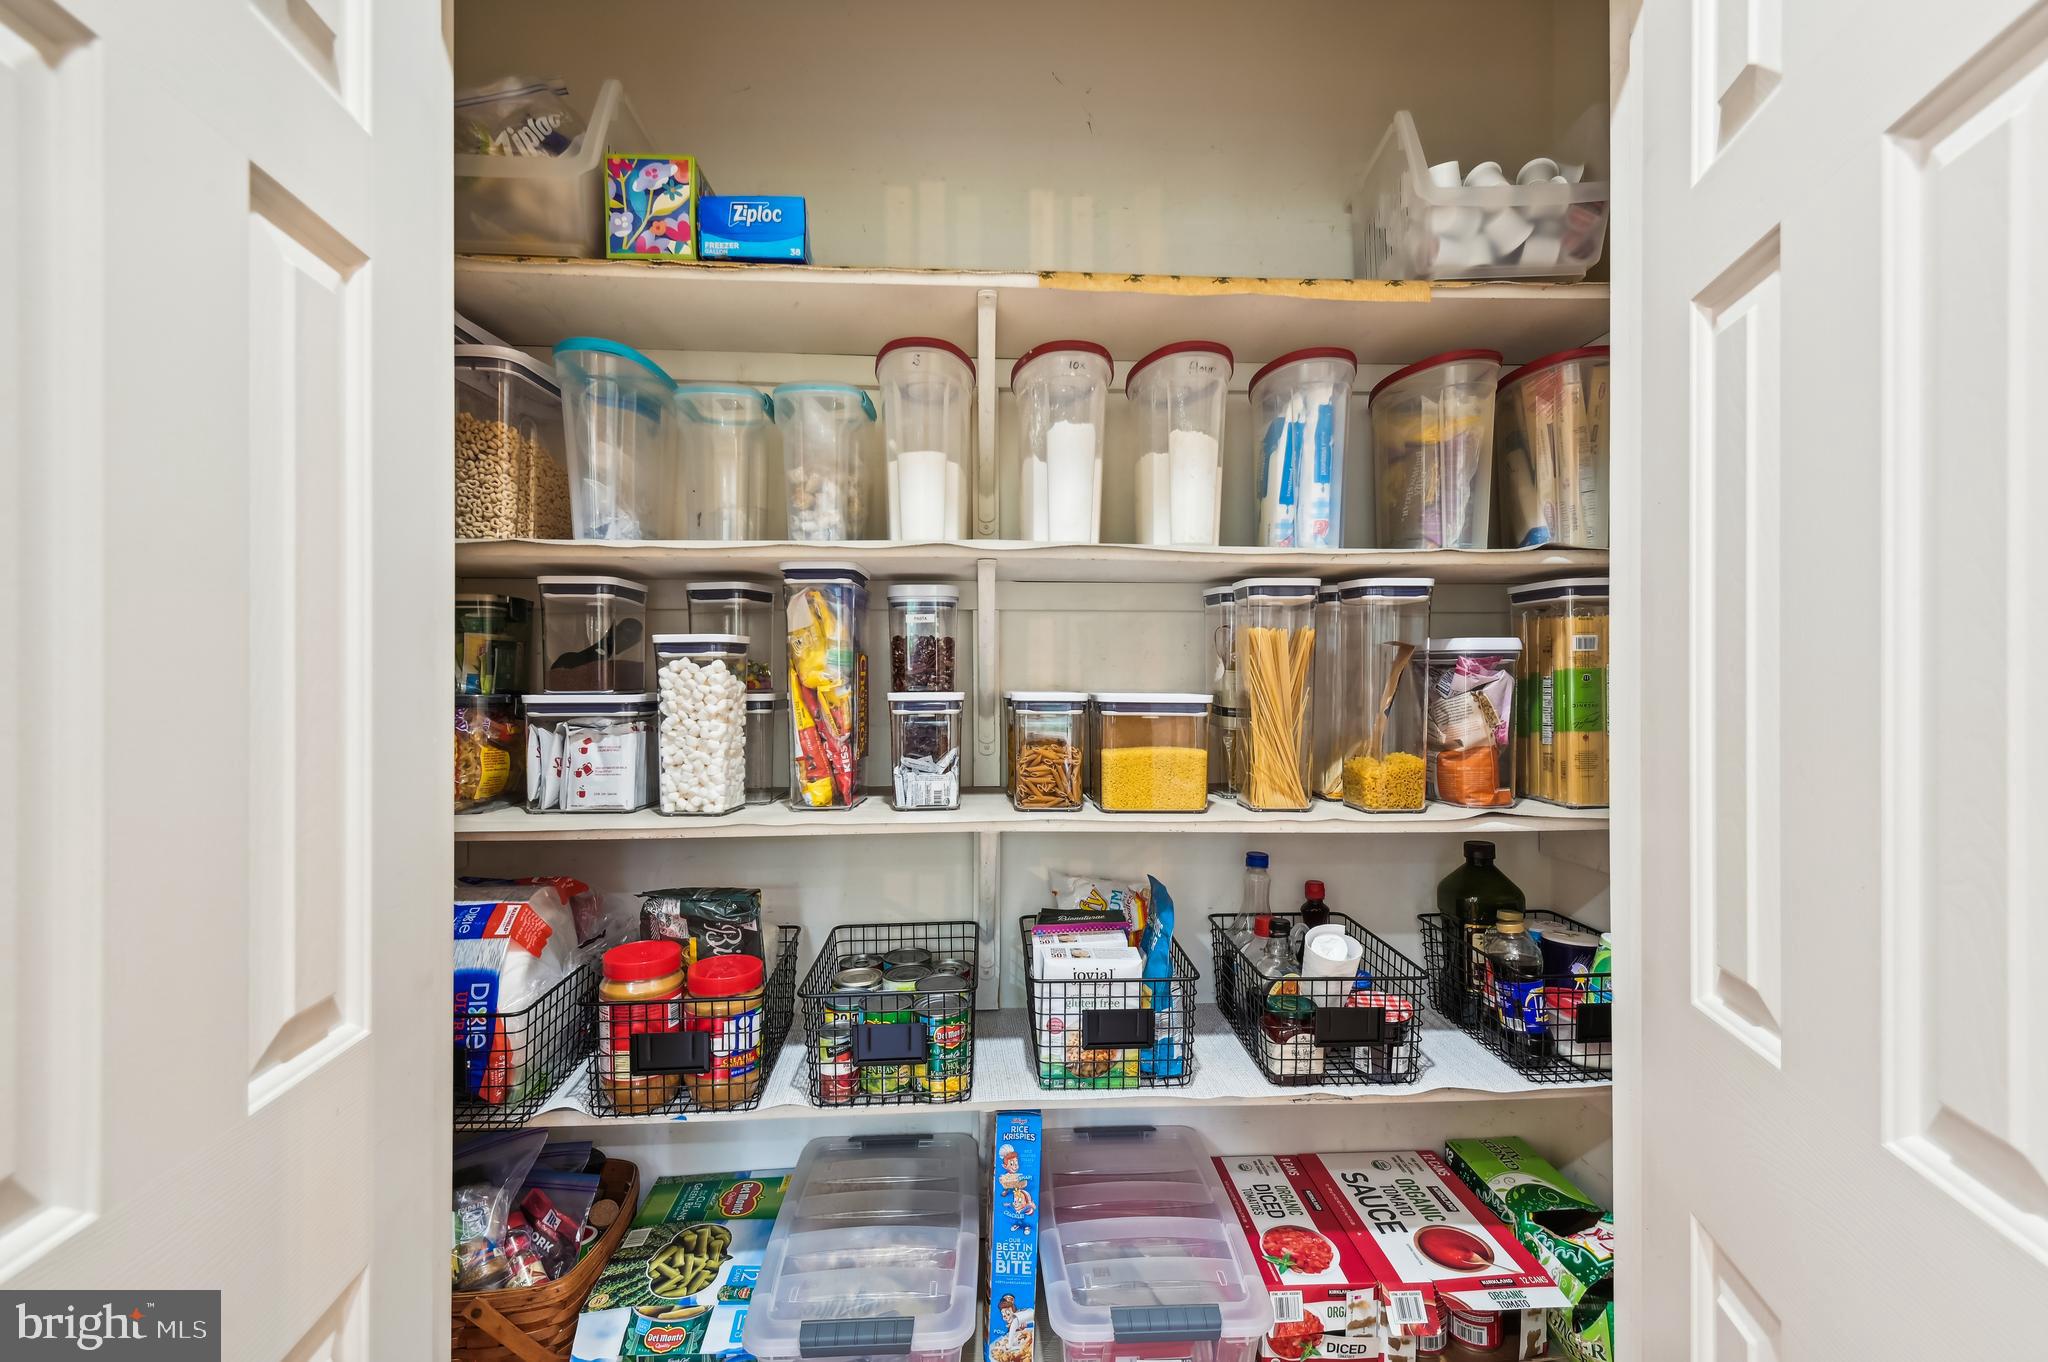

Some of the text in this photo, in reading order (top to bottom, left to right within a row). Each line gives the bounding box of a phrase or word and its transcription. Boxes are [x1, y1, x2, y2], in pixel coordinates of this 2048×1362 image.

[733, 205, 781, 226] Ziploc
[1100, 998, 1120, 1008] free
[1003, 1133, 1036, 1141] KRISPIES
[1283, 1161, 1300, 1177] CANS
[1428, 1161, 1450, 1176] CANS
[677, 1183, 702, 1220] GREEN BEANS
[732, 1194, 748, 1214] Monte
[1242, 1189, 1264, 1215] TOMATOES
[1253, 1183, 1286, 1218] DICED
[1274, 1184, 1304, 1217] ORGANIC
[1341, 1172, 1408, 1235] SAUCE
[1380, 1185, 1416, 1218] TOMATO
[1394, 1178, 1446, 1224] ORGANIC
[531, 1232, 556, 1254] ORK
[996, 1243, 1033, 1252] BEST IN
[996, 1251, 1032, 1260] EVERY
[995, 1260, 1032, 1275] BITE
[1519, 1276, 1528, 1284] 12
[1529, 1275, 1549, 1283] CANS
[1488, 1290, 1527, 1301] ORGANIC
[1496, 1300, 1531, 1310] TOMATO
[648, 1333, 684, 1342] Del Monte
[1326, 1342, 1368, 1355] DICED
